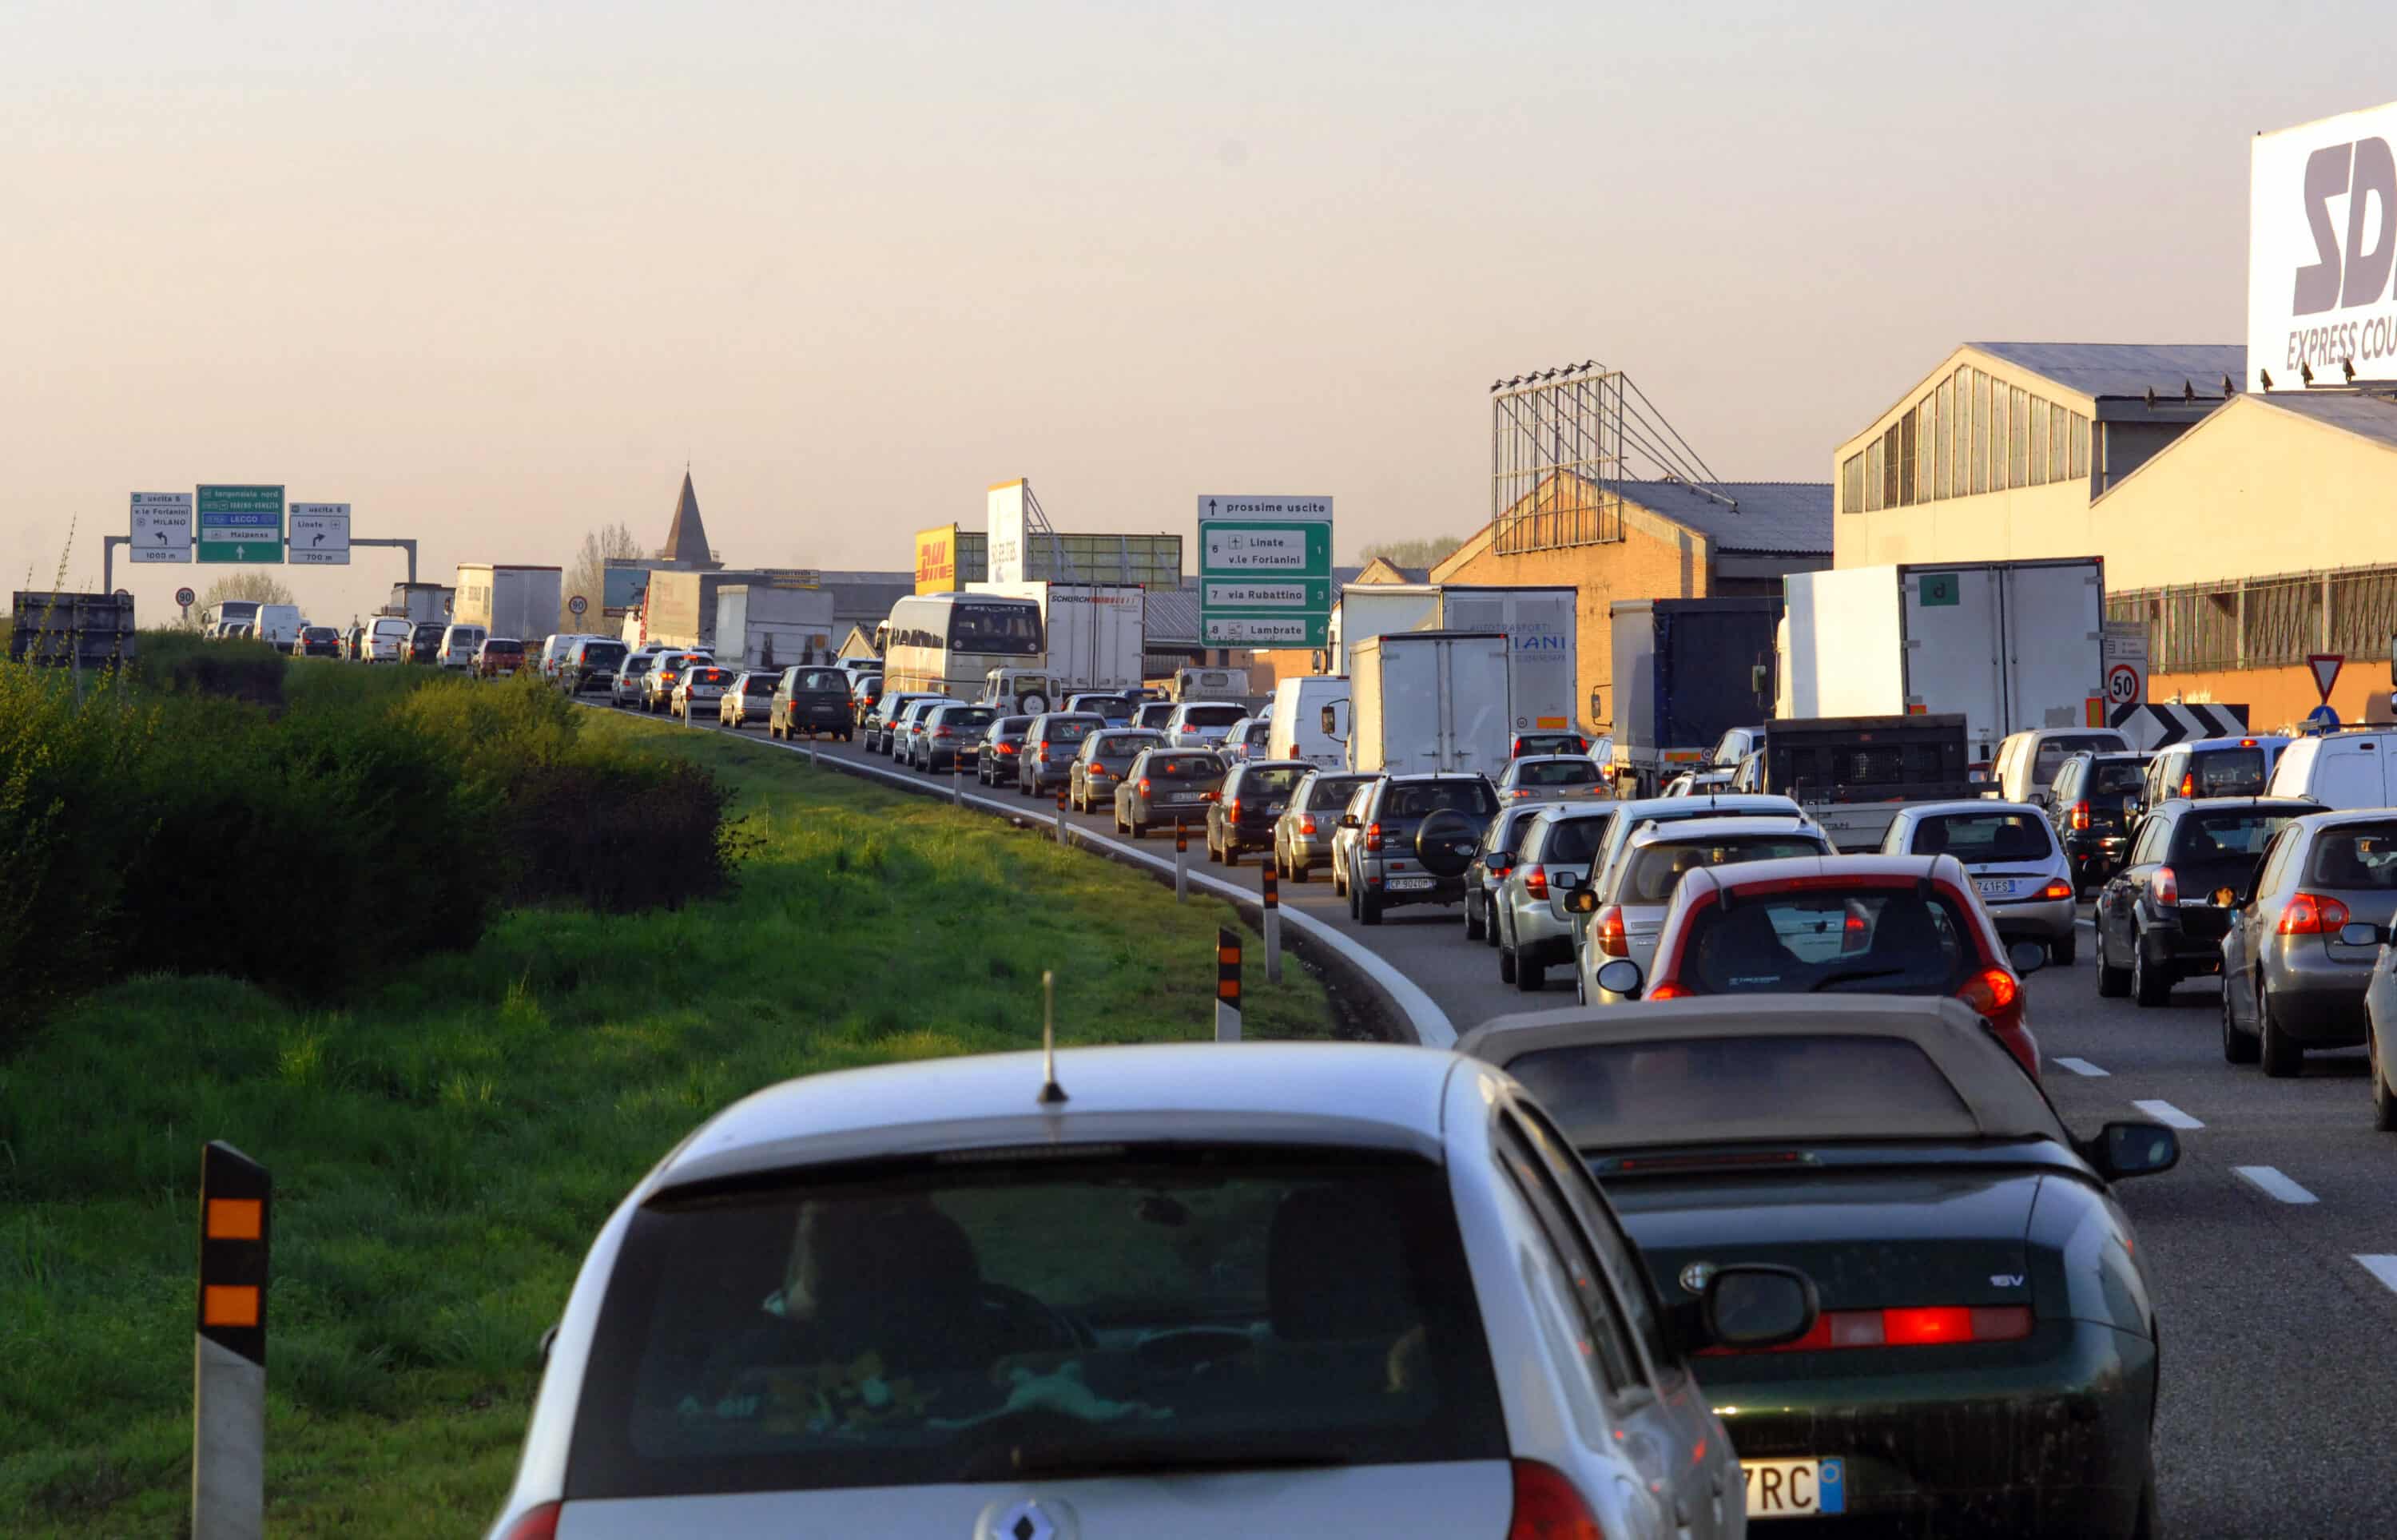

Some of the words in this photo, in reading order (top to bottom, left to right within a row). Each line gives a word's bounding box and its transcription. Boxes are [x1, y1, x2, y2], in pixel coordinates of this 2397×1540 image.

[2292, 137, 2397, 317] SD
[2286, 321, 2358, 371] EXPRESS
[1226, 502, 1282, 514] prossime
[1287, 502, 1326, 512] uscite
[1250, 538, 1284, 547] Linate
[1212, 545, 1218, 554] 6
[1317, 546, 1322, 554] 1
[920, 542, 948, 582] DHL
[1228, 555, 1247, 564] v.le
[1252, 555, 1300, 564] Forlanini
[179, 593, 191, 601] 90
[1211, 589, 1218, 598] 7
[1227, 590, 1244, 599] via
[1248, 590, 1302, 599] Rubattino
[1212, 625, 1218, 634] 8
[1250, 625, 1302, 634] Lambrate
[1317, 625, 1324, 634] 4
[2113, 676, 2133, 696] 50
